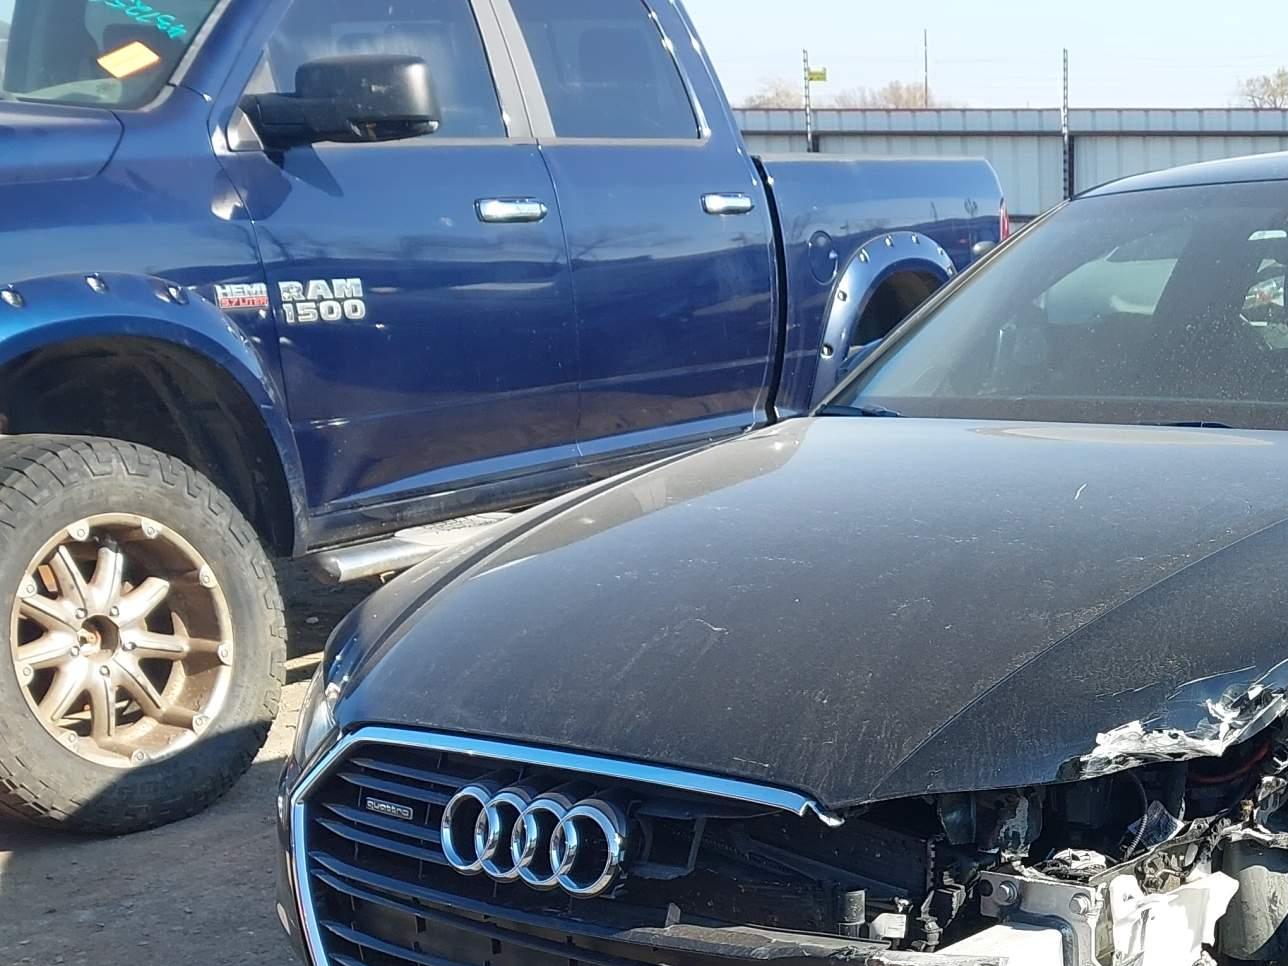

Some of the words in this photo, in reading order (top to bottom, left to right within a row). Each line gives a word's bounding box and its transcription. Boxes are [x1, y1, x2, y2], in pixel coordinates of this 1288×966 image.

[215, 282, 267, 298] HEMI
[278, 278, 364, 302] RAM
[282, 299, 366, 324] 1500
[366, 800, 410, 817] quattro
